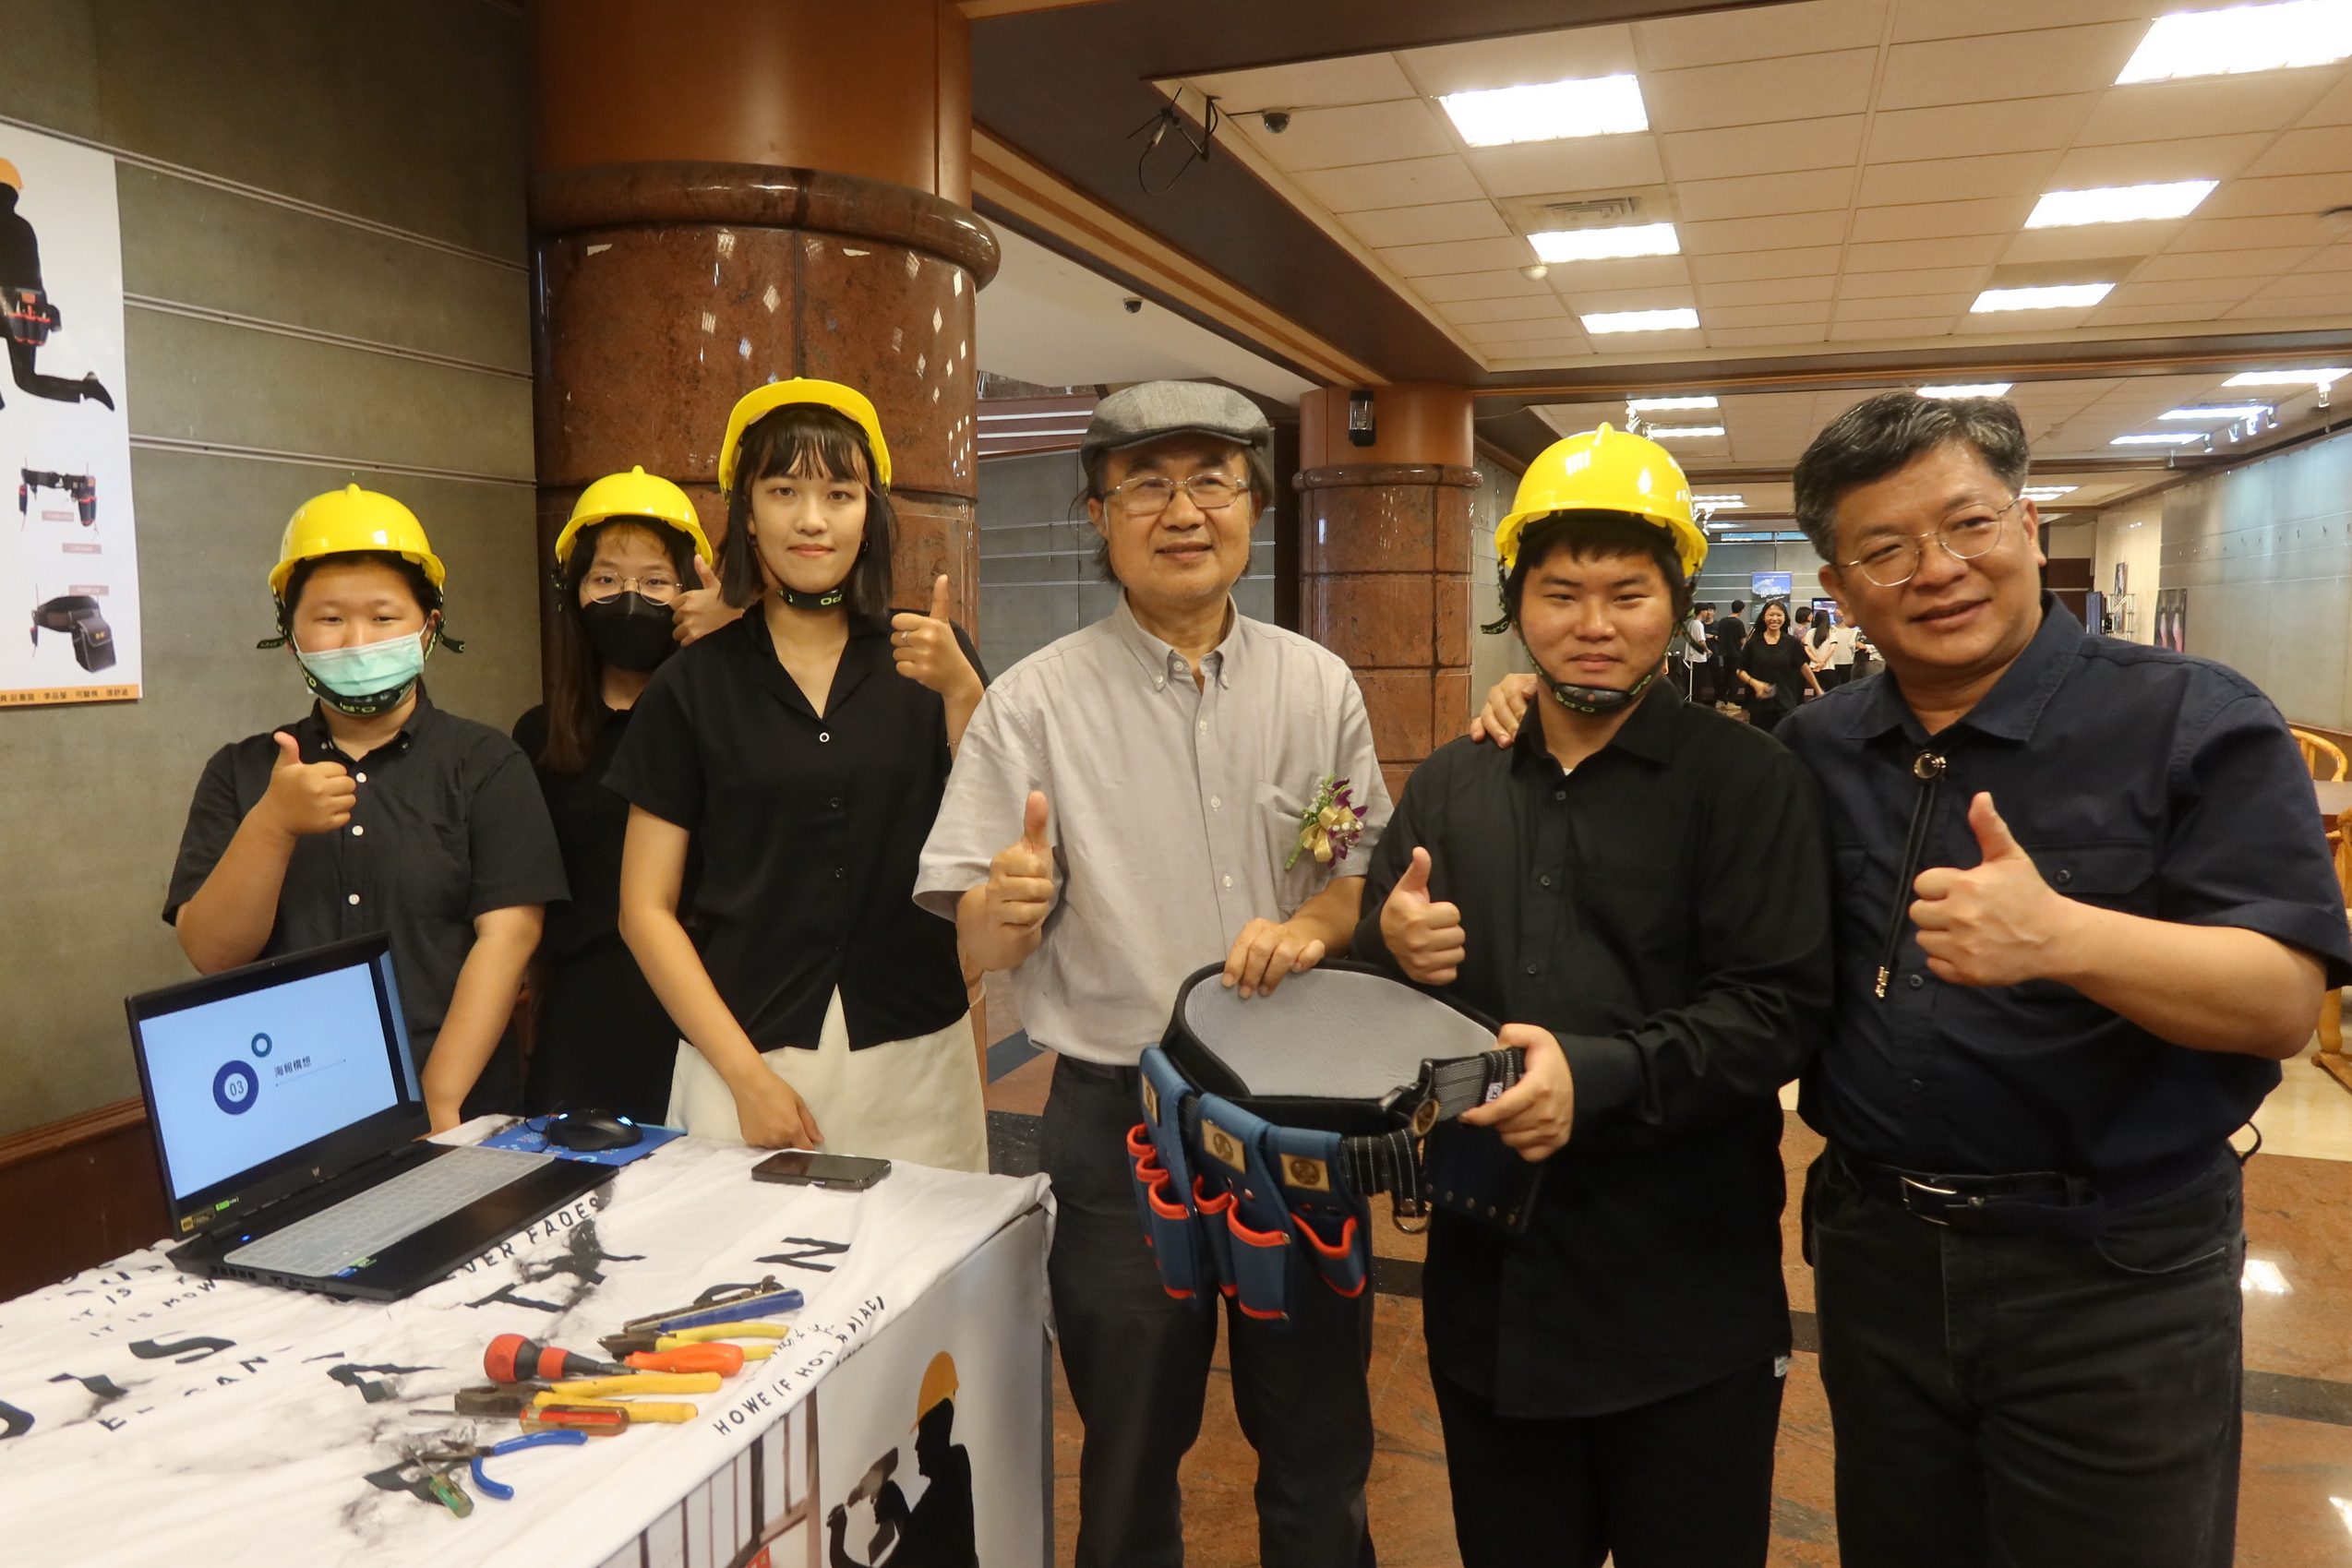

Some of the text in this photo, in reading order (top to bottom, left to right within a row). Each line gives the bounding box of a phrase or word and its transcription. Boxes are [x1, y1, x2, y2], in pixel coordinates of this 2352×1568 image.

[274, 1056, 312, 1078] 海報構想
[229, 1080, 245, 1096] 03
[446, 1242, 516, 1279] VER
[713, 1392, 772, 1436] HOWE
